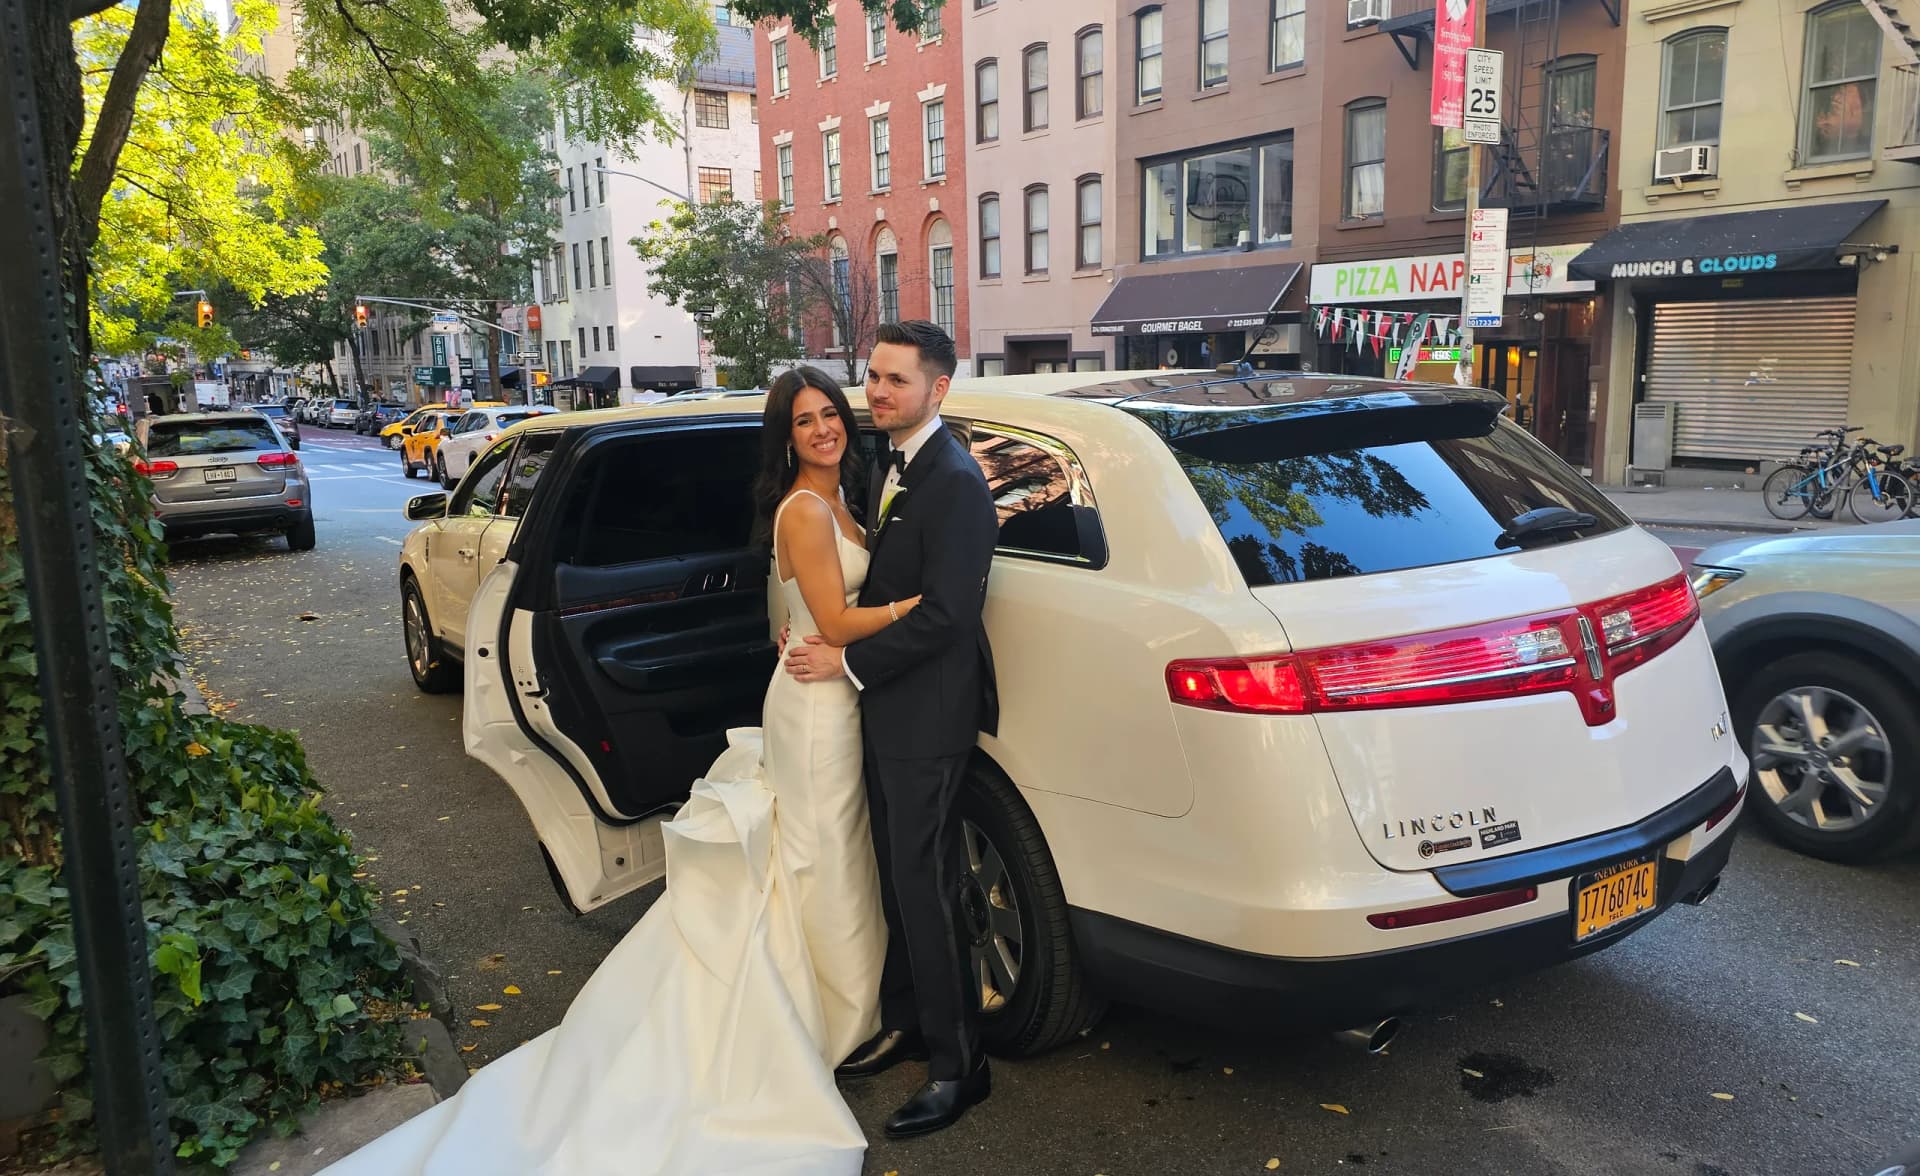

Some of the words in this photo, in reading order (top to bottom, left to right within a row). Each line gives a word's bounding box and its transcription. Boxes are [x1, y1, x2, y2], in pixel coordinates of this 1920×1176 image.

[1477, 54, 1491, 63] CITY
[1473, 65, 1494, 75] SPEED
[1475, 77, 1492, 85] LIMIT
[1471, 88, 1496, 114] 25
[1473, 124, 1491, 132] PHOTO
[1467, 131, 1497, 140] ENFORCED
[1611, 260, 1677, 278] MUNCH
[1682, 259, 1695, 275] &
[1699, 253, 1778, 274] CLOUDS
[1335, 265, 1400, 297] PIZZA
[1141, 321, 1177, 333] GOURMET
[1177, 320, 1204, 332] BAGEL
[1383, 806, 1498, 840] LINCOLN
[1504, 821, 1518, 830] PARK
[1596, 864, 1618, 880] NEW
[1617, 859, 1640, 871] YORK
[1580, 867, 1649, 923] J776874C
